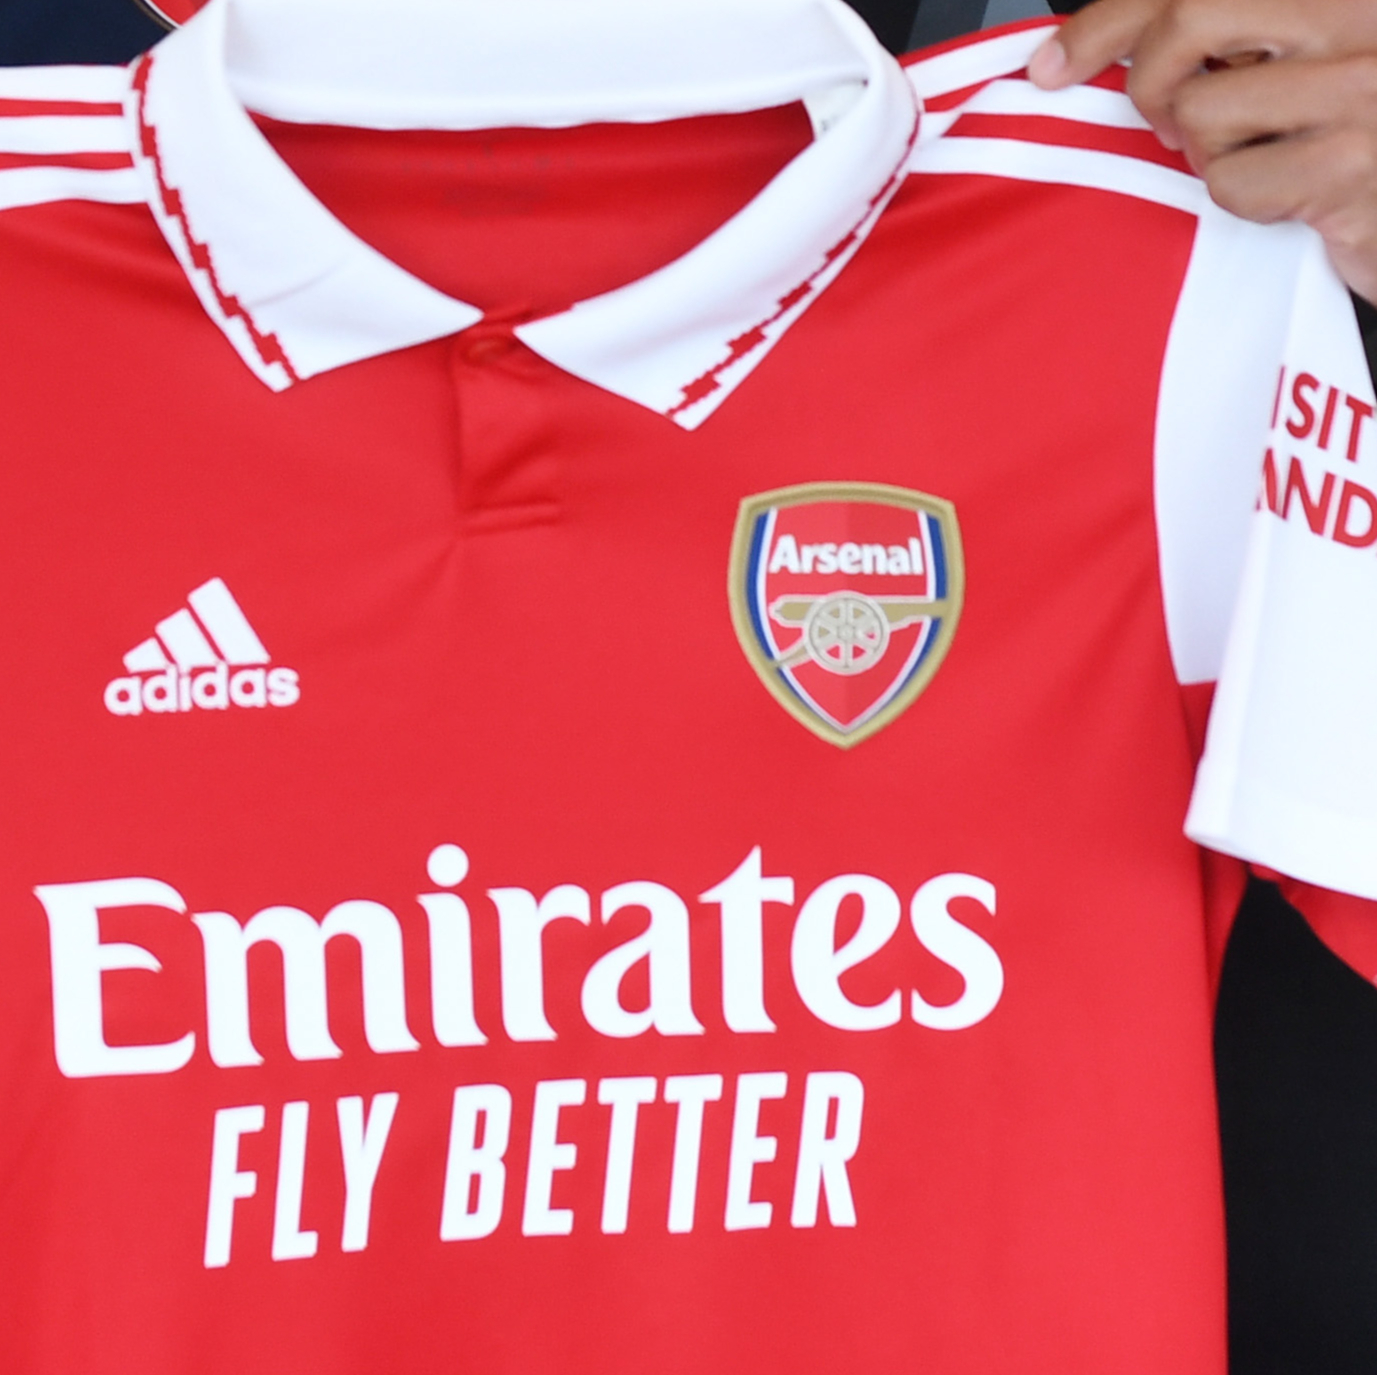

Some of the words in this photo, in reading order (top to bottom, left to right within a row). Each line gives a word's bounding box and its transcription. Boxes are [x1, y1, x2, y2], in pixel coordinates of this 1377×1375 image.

[1269, 364, 1376, 464] ISIT
[768, 533, 925, 577] Arsenal
[103, 662, 302, 717] adidas
[33, 843, 1005, 1078] Emirates
[203, 1091, 400, 1269] FLY
[439, 1070, 865, 1242] BETTER
